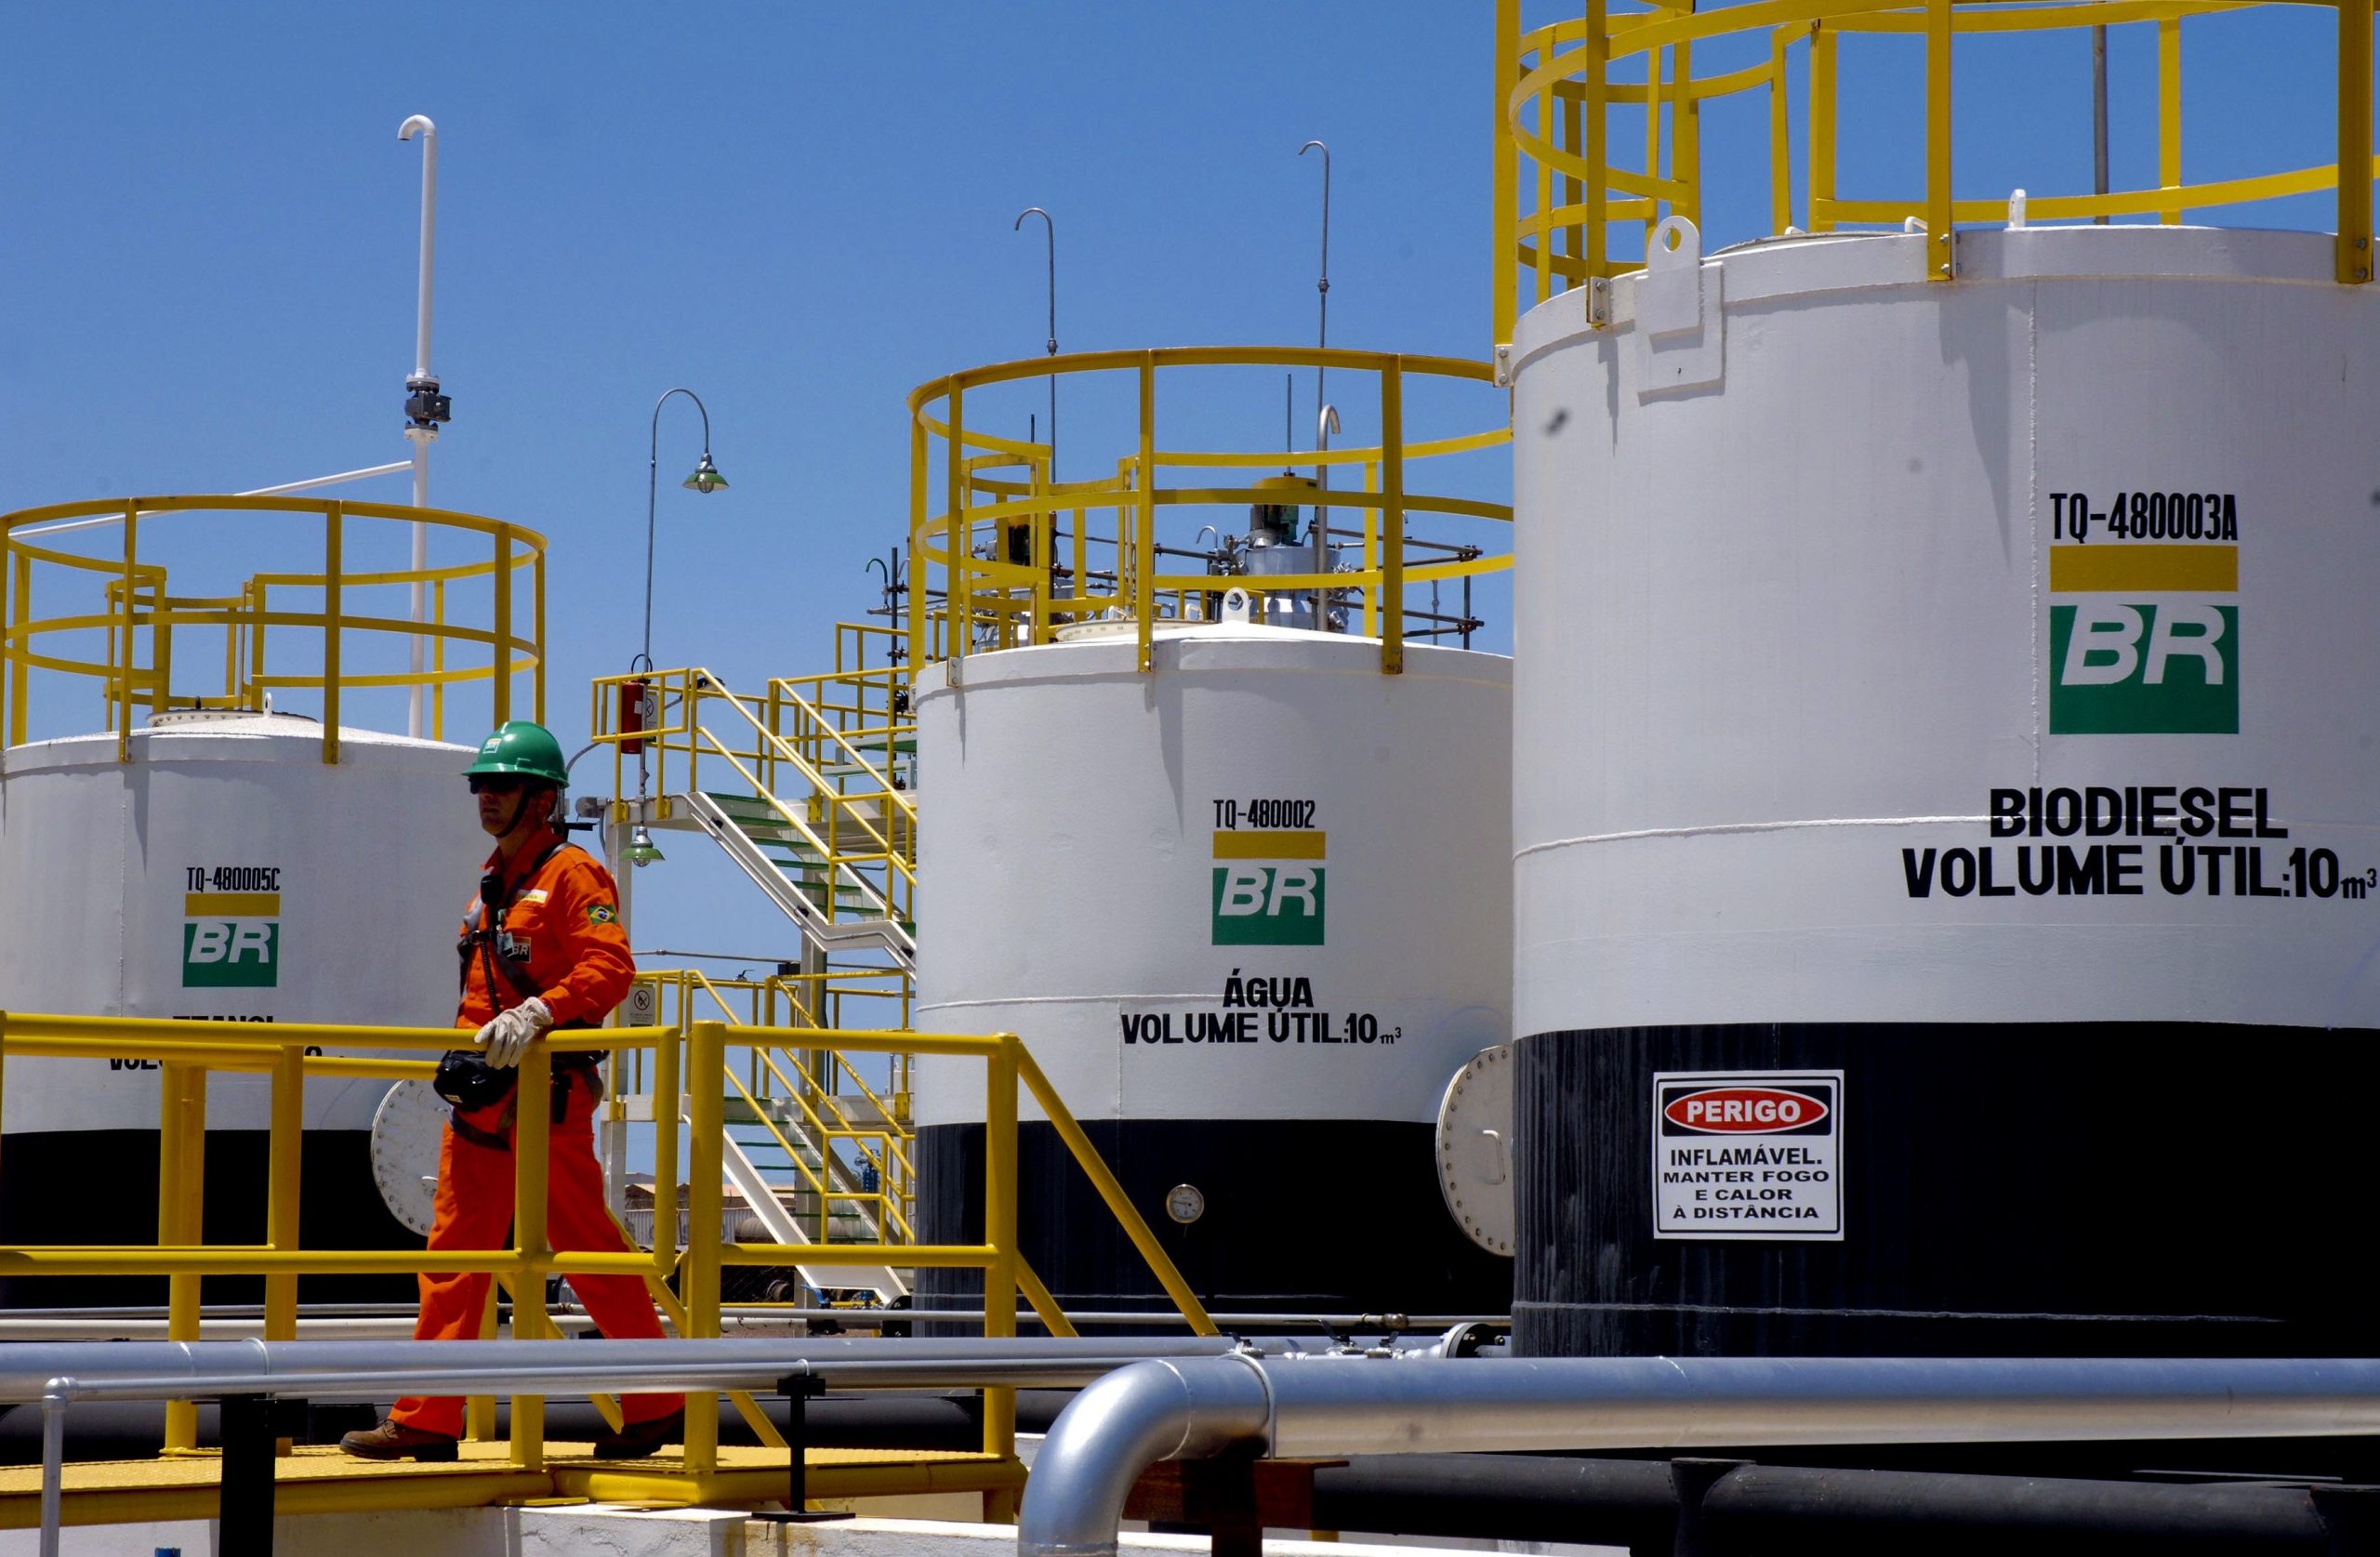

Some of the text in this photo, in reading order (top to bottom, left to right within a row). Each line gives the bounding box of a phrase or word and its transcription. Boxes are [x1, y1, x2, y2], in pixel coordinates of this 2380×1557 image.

[2049, 492, 2239, 544] TQ-480003A
[2061, 603, 2226, 686] BR
[1212, 798, 1316, 830] TQ-480002
[1990, 786, 2289, 838] BIODIESEL
[186, 866, 281, 893] TQ-480005C
[1902, 844, 2144, 898] VOLUME
[1218, 866, 1317, 917] BR
[188, 922, 272, 963] BR
[1223, 968, 1315, 1008] ÁGUA
[1120, 1012, 1259, 1045] VOLUME
[1686, 1100, 1801, 1123] PERIGO
[1671, 1143, 1822, 1167] INFLAMÁVEL.
[1663, 1170, 1830, 1183] MANTER FOGO
[1695, 1189, 1792, 1201] E CALOR
[1673, 1205, 1819, 1219] À DISTÂNCIA
